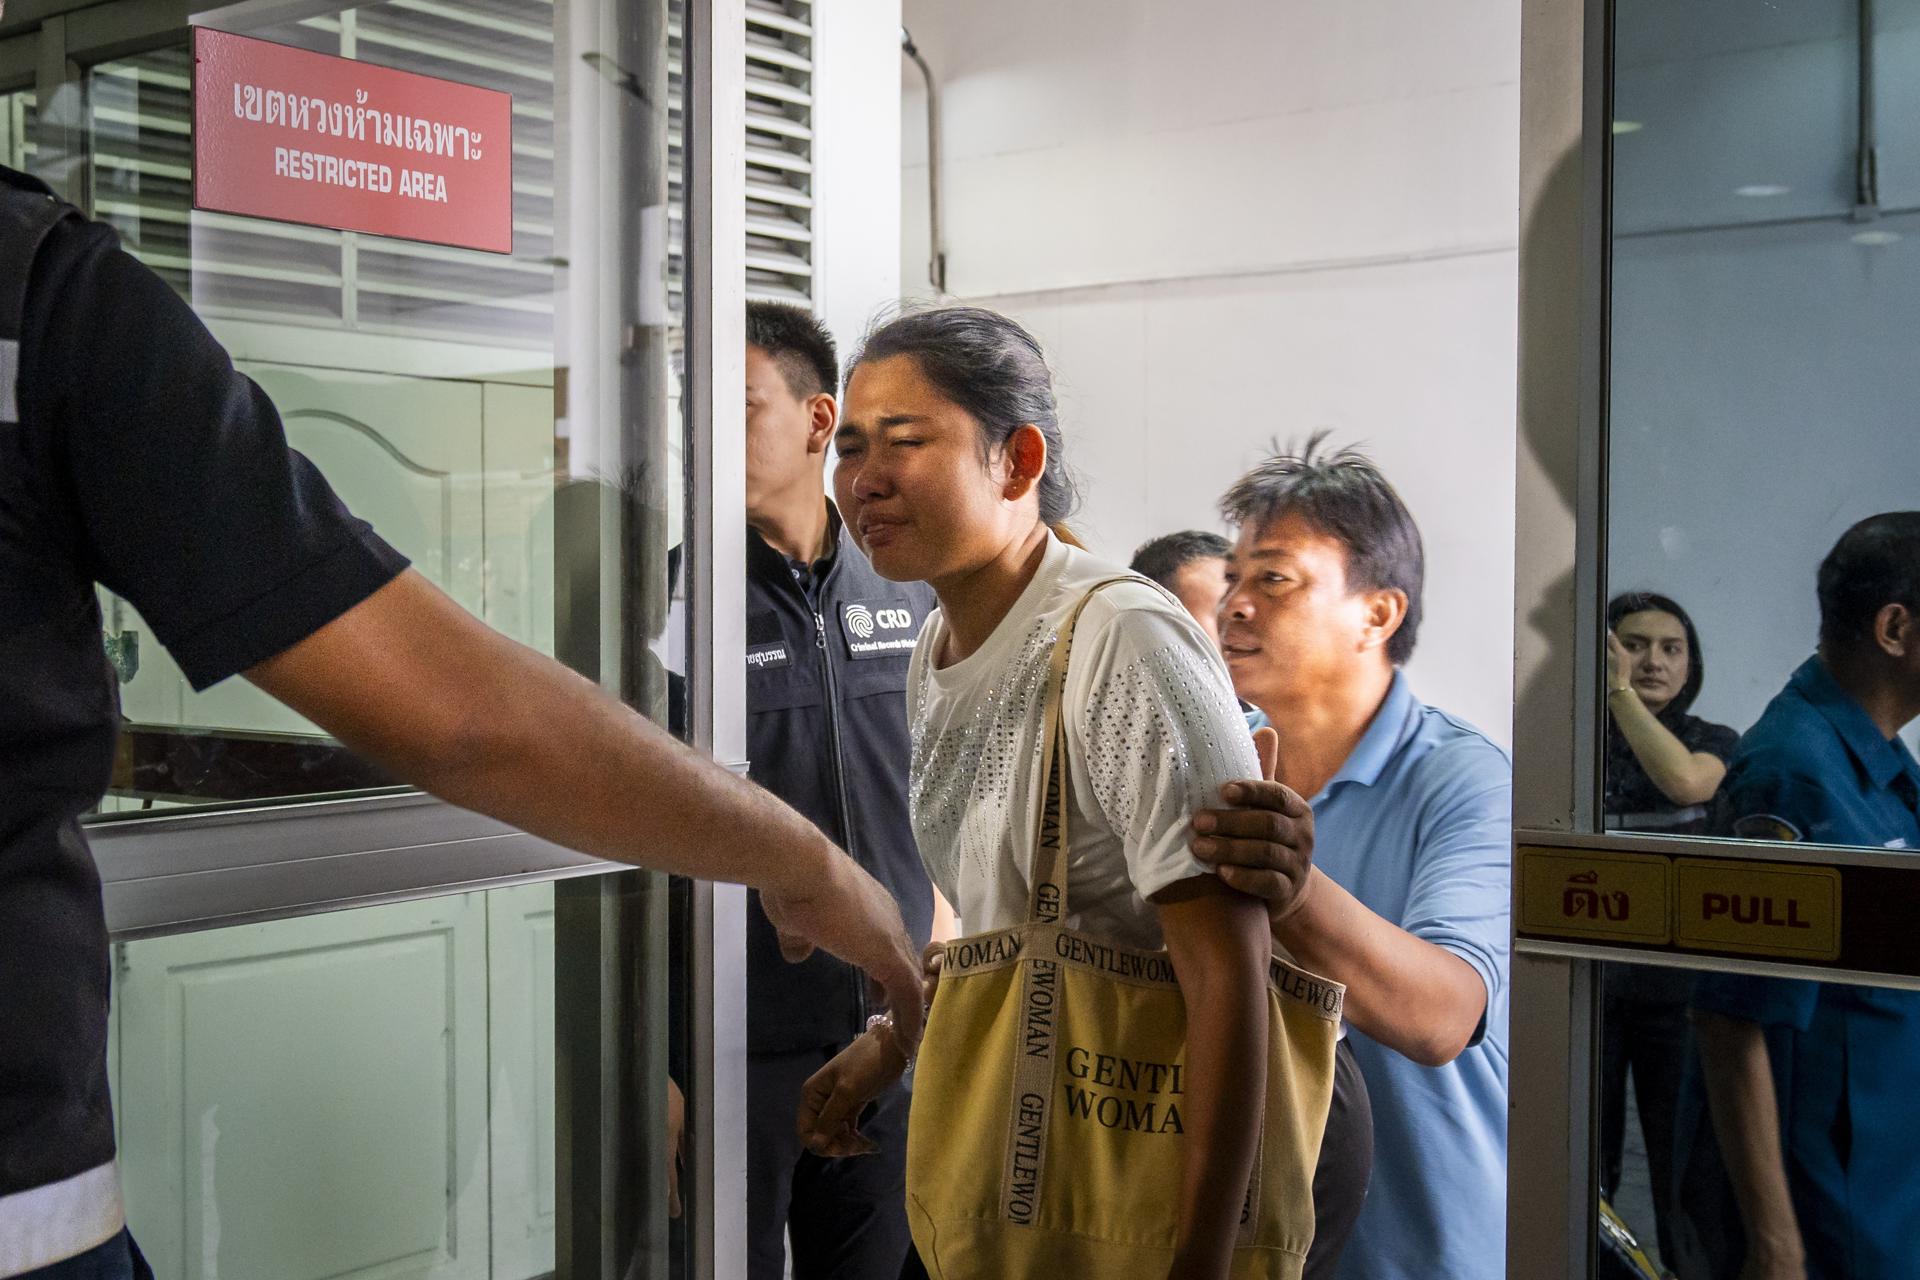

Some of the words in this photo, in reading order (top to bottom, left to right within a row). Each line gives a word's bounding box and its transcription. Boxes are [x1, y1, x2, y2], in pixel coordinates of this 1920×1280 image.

[234, 83, 482, 161] เขตหวงห้ามเฉพาะ
[275, 147, 392, 193] RESTRICTED
[399, 169, 448, 203] AREA
[876, 609, 912, 629] CRD
[1563, 870, 1630, 921] ดึง
[1702, 893, 1811, 929] PULL
[943, 932, 1022, 970] WOMAN
[1064, 1084, 1184, 1134] WOMA
